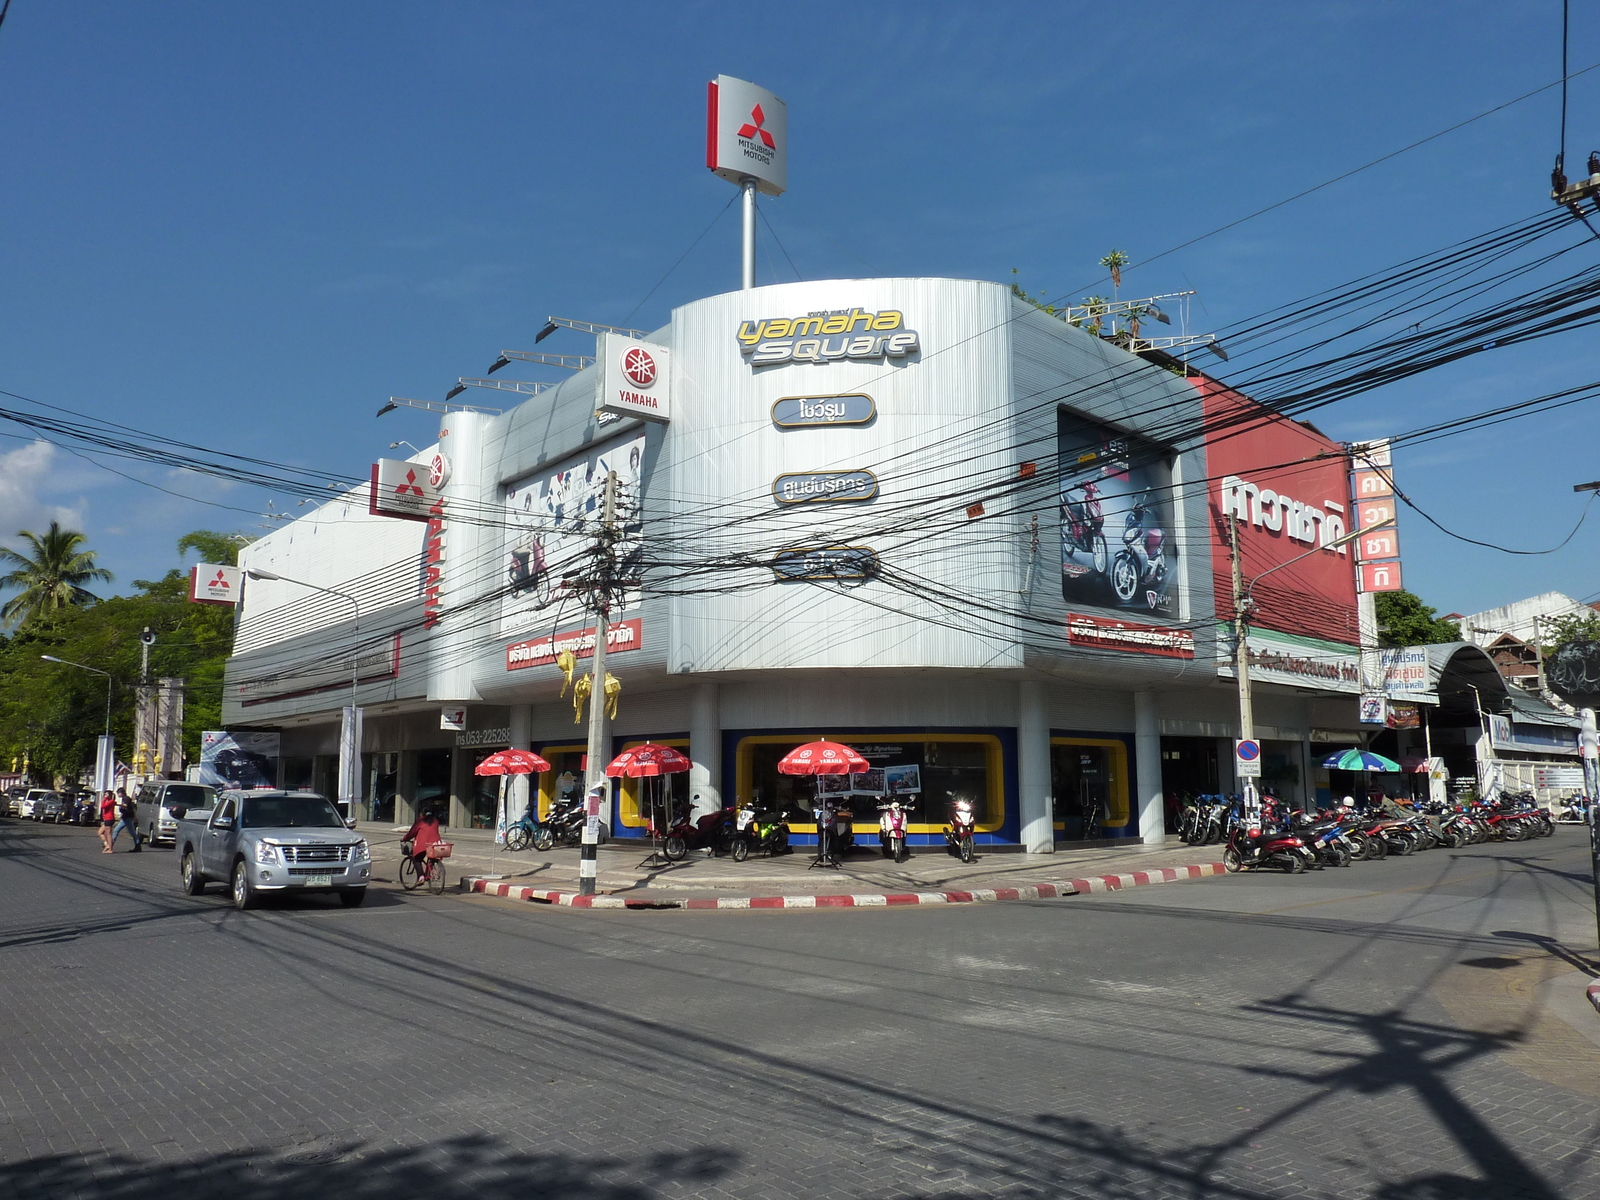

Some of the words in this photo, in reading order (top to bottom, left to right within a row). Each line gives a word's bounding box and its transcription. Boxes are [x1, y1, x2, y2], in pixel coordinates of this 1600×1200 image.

[738, 139, 775, 159] MITSUBISHI
[743, 149, 771, 165] MOTORS
[738, 309, 902, 345] yamaha
[619, 390, 658, 409] YAMAHA
[799, 398, 846, 421] โชว์รูม
